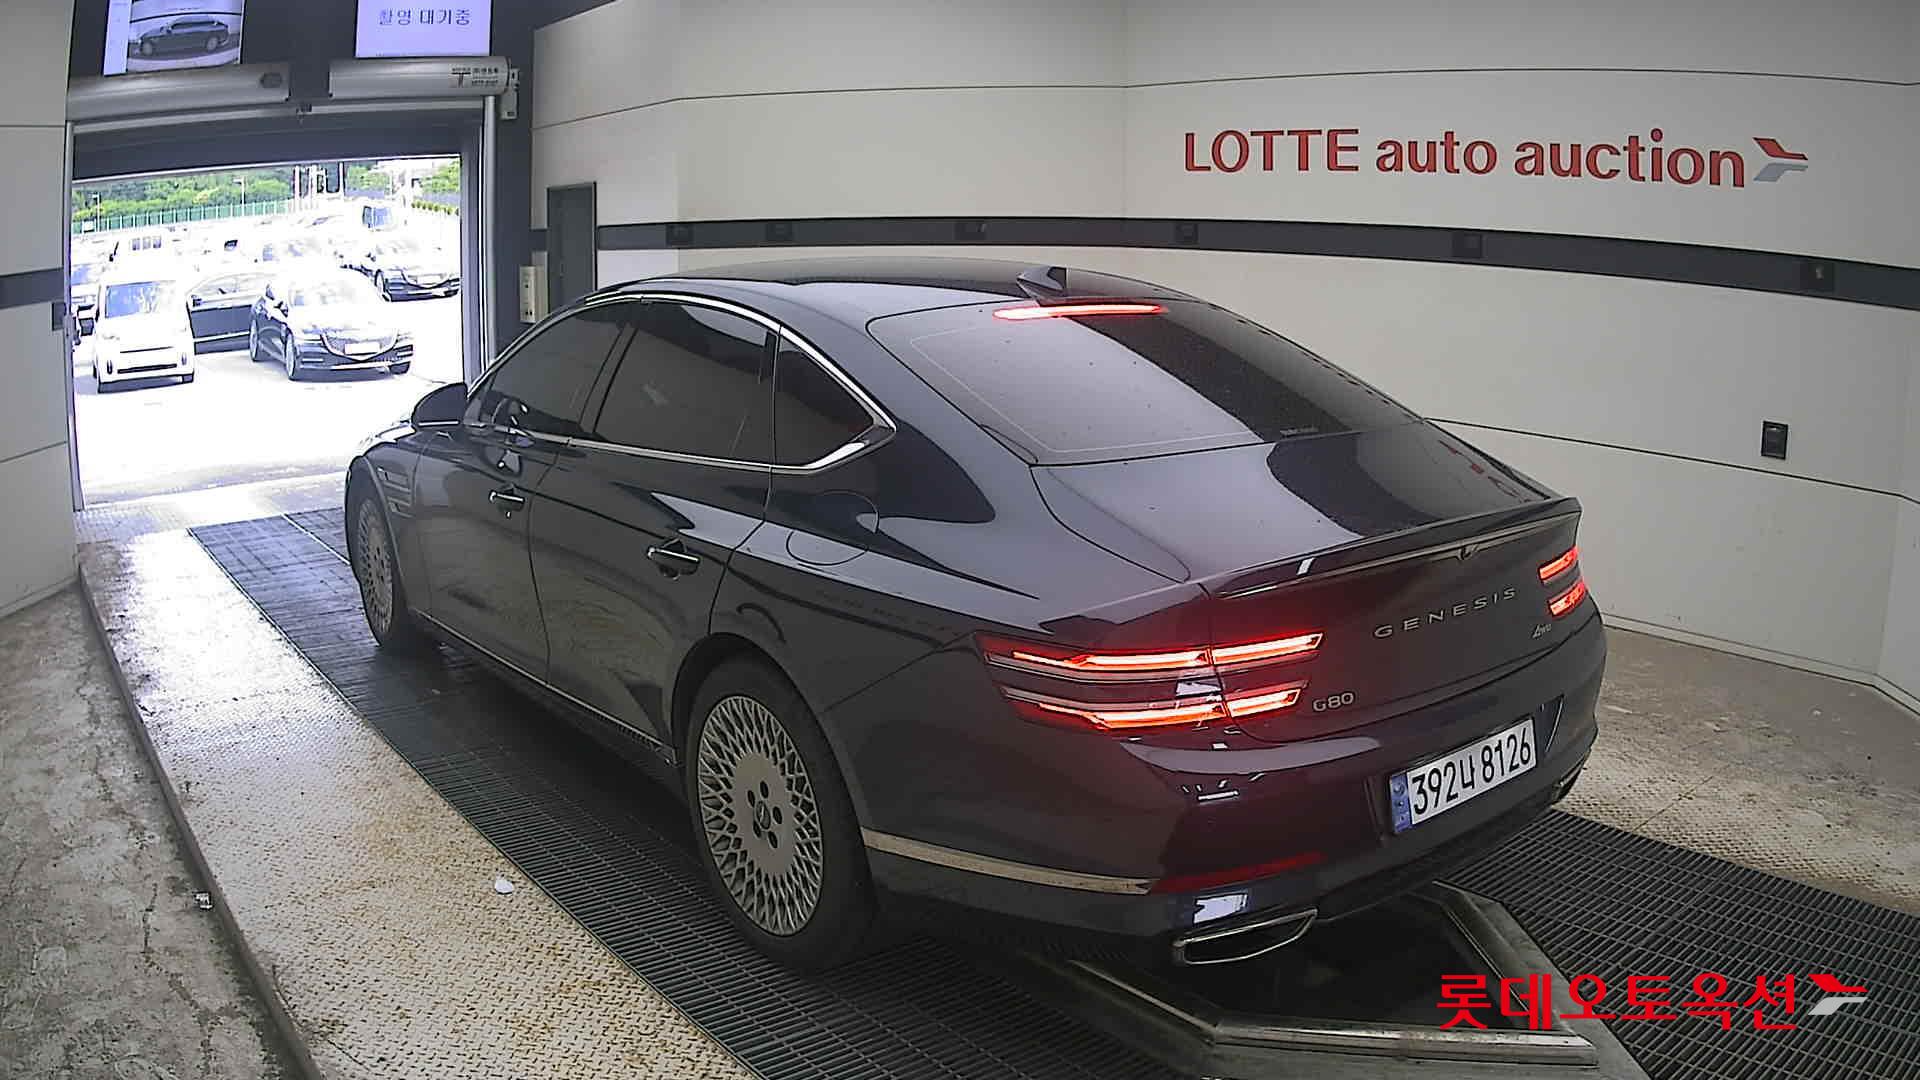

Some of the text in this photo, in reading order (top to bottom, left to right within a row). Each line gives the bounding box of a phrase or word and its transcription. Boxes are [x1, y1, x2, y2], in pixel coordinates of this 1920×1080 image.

[419, 8, 471, 26] 대기중
[1185, 128, 1745, 188] LOTTE auto auction
[1373, 587, 1517, 639] GENESIS
[1312, 692, 1355, 712] G80
[1411, 727, 1531, 815] 392나 8126
